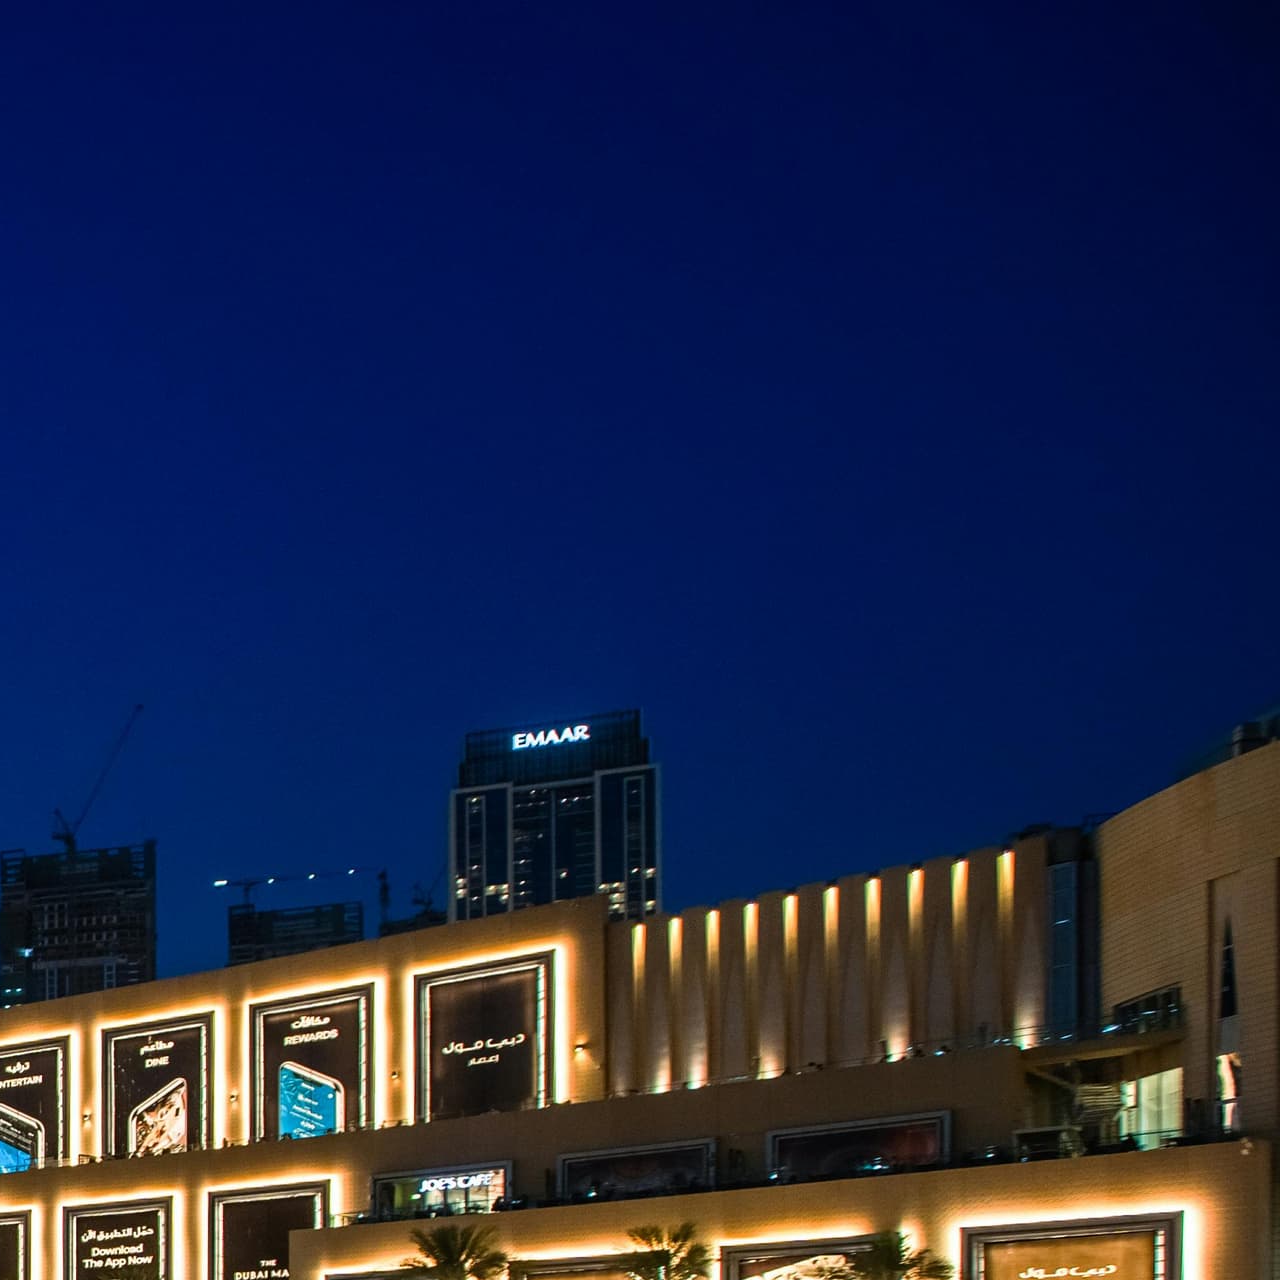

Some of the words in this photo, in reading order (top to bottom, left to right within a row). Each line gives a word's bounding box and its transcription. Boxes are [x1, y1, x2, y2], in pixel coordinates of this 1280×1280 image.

[512, 725, 590, 750] EMAAR
[284, 1029, 338, 1046] REWARDS
[145, 1056, 169, 1068] DINE
[91, 1244, 144, 1257] Download
[82, 1258, 103, 1269] The
[105, 1256, 127, 1268] App
[128, 1255, 153, 1266] Now
[234, 1270, 268, 1280] DUBAI
[271, 1269, 290, 1278] MA
